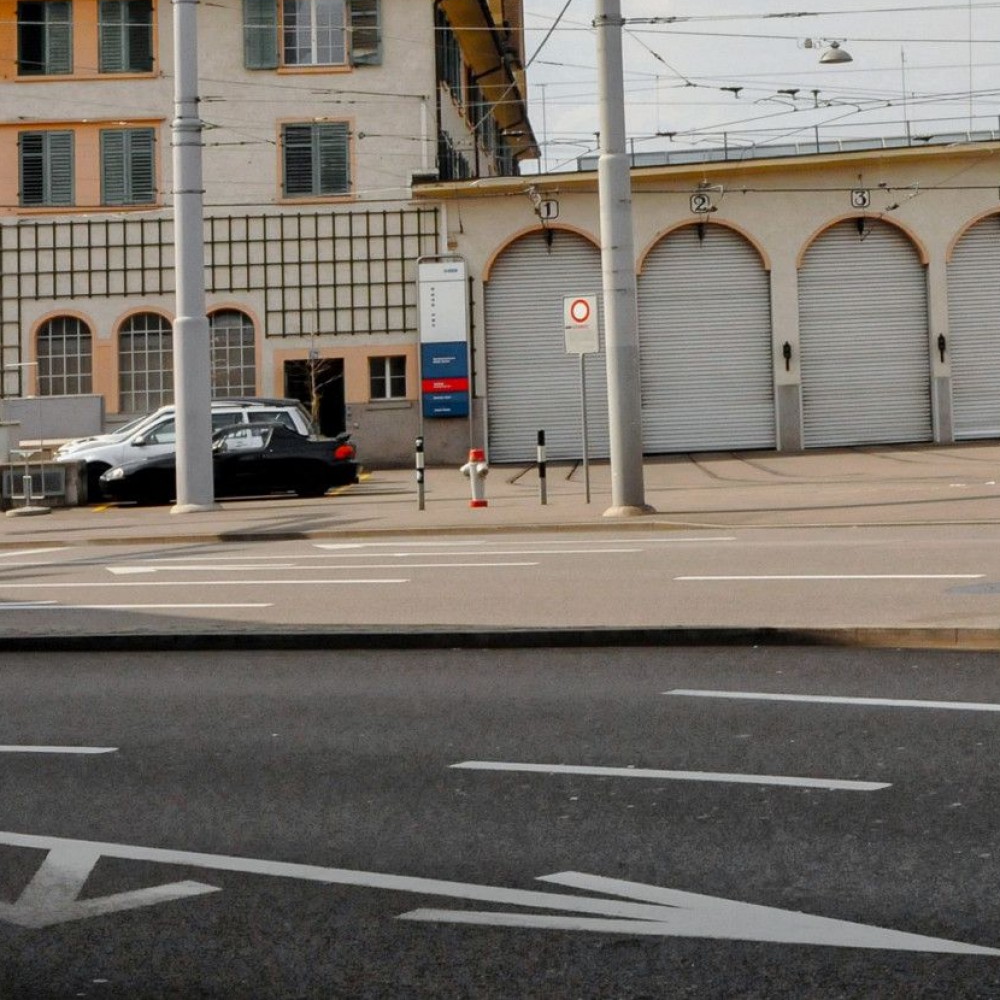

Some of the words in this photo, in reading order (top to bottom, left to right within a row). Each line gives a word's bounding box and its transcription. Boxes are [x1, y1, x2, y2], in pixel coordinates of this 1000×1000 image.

[694, 196, 707, 211] 2
[855, 190, 866, 206] 3
[543, 202, 551, 217] 1
